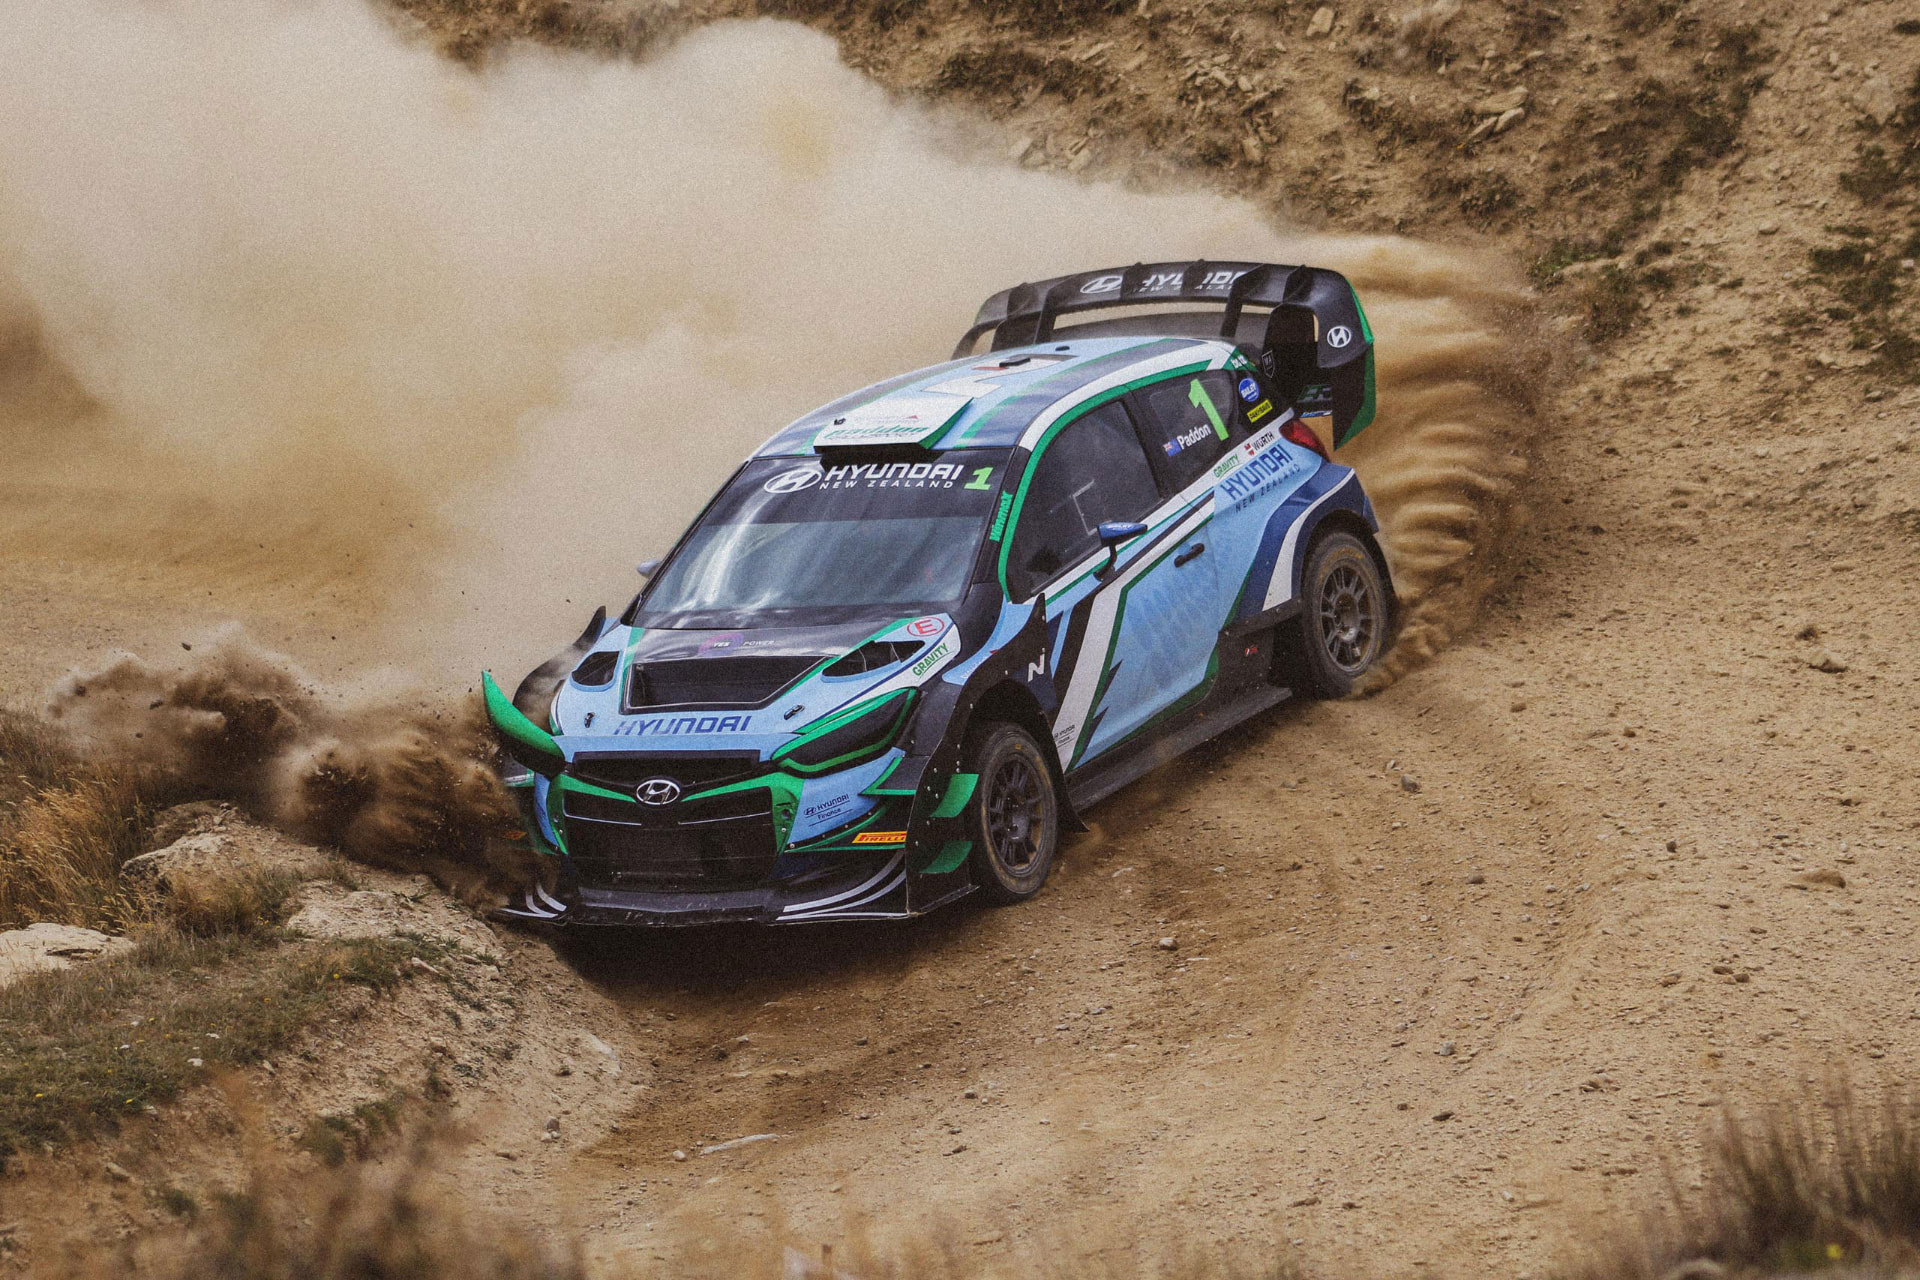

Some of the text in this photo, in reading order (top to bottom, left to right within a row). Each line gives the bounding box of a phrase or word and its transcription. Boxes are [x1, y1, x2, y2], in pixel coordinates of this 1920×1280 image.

[1188, 379, 1229, 441] 1
[1176, 424, 1212, 450] Paddon
[824, 463, 994, 490] HYUNDAI 1
[1213, 454, 1240, 478] GRAVITY
[1220, 444, 1293, 501] HYUNDAI
[819, 480, 954, 490] NEW ZEALAND
[1236, 464, 1300, 512] NEW ZEALAND
[914, 619, 938, 634] E
[912, 642, 948, 676] GRAVITY
[613, 716, 753, 736] HYUNDAI
[817, 794, 849, 811] HYUNDAI
[818, 808, 842, 820] Finance
[857, 833, 906, 842] PIRELLI
